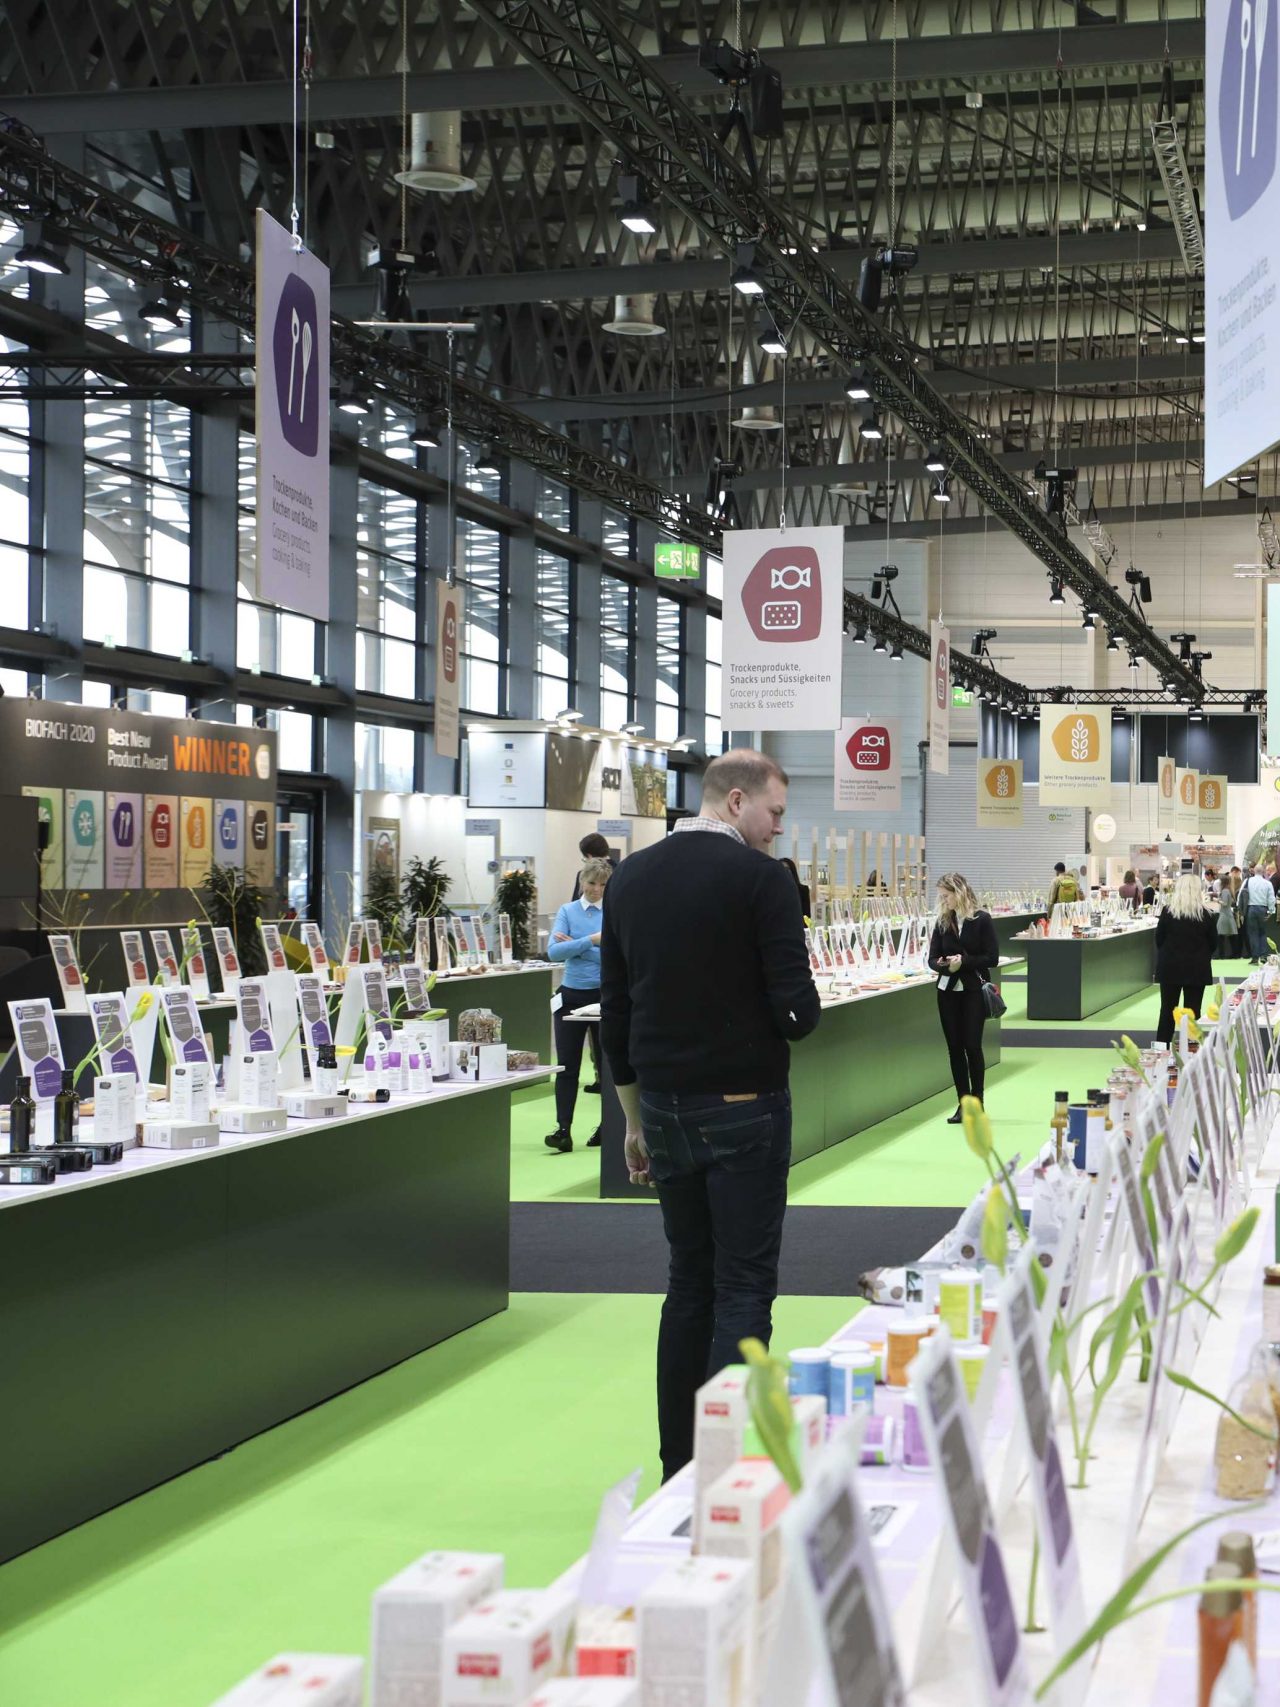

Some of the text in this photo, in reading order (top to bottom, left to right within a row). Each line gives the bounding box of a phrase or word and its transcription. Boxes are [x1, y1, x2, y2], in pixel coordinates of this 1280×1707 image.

[291, 512, 301, 525] und
[730, 662, 801, 673] Trockenprodukte,
[730, 675, 759, 684] Snacks
[760, 674, 776, 684] und
[729, 688, 760, 698] Grocery
[729, 700, 794, 709] snacks & sweets
[25, 718, 96, 744] BIOFACH 2020
[107, 728, 151, 749] Best New
[107, 749, 169, 771] Product Award
[172, 734, 251, 778] WINNER
